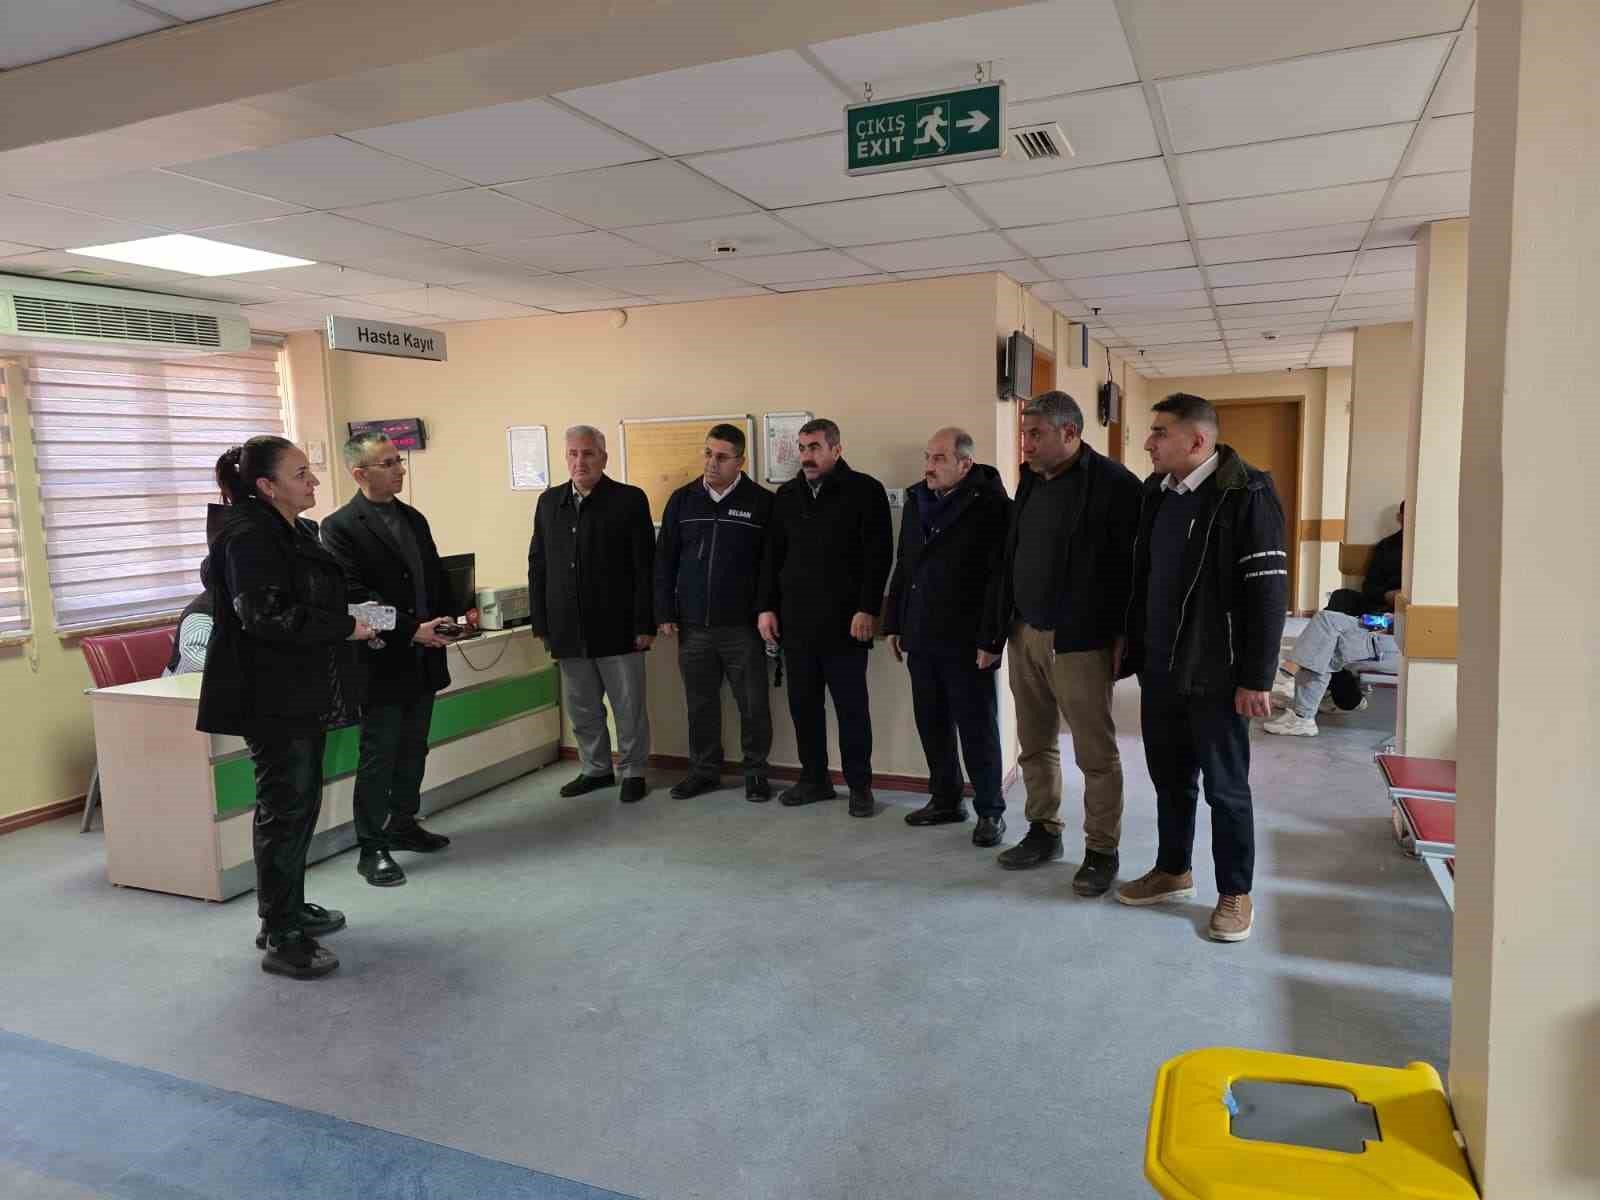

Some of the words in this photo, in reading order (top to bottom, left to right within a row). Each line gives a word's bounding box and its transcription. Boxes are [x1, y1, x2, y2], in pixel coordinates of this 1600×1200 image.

[856, 114, 906, 139] ÇIKIŞ
[857, 136, 905, 159] EXIT
[358, 327, 400, 346] Hasta
[404, 333, 434, 352] Kayıt
